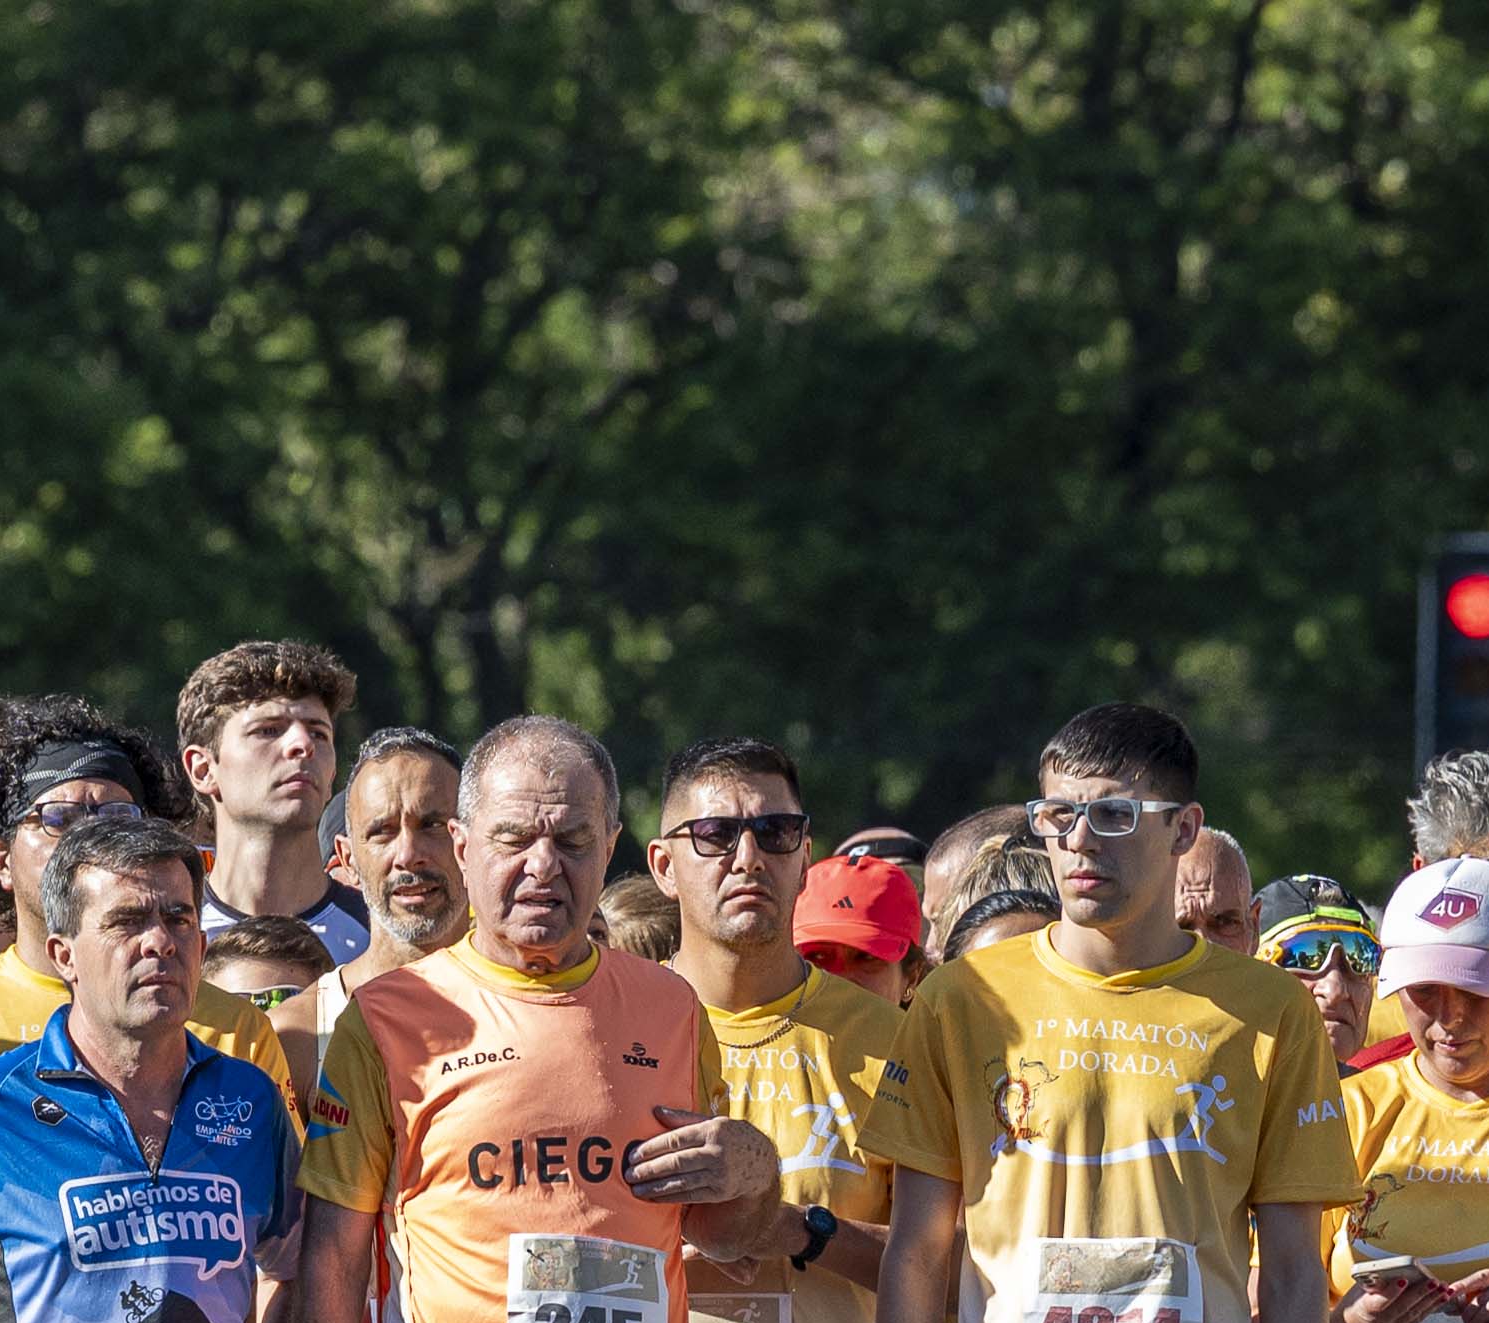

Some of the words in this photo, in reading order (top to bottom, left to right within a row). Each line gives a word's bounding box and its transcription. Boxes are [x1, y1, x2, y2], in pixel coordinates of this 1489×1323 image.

[1431, 900, 1465, 919] 4U
[1065, 1017, 1210, 1051] MARATÓN
[440, 1046, 521, 1075] A.R.De.C.
[1057, 1049, 1180, 1079] DORADA
[73, 1183, 199, 1219] hablemos
[205, 1176, 232, 1203] de
[73, 1206, 242, 1256] autismo
